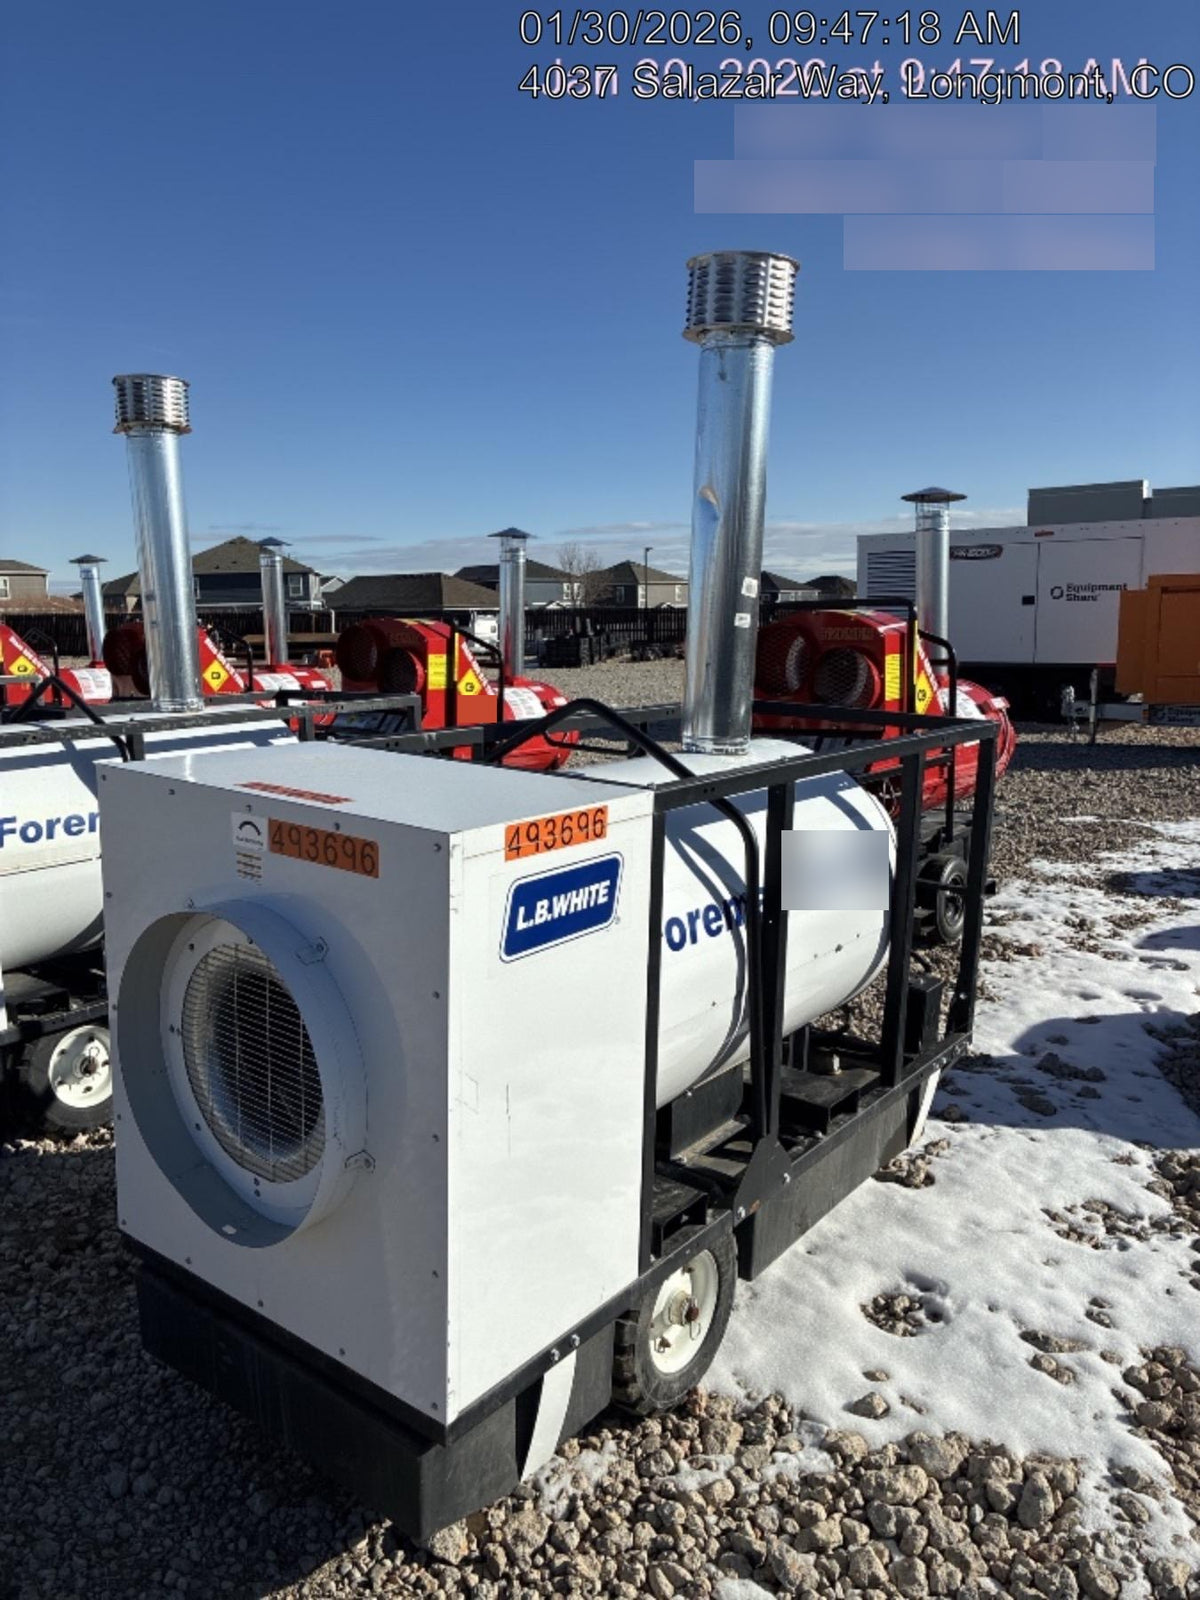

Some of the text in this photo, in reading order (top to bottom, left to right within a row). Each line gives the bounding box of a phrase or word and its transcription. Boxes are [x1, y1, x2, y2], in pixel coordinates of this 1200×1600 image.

[271, 822, 376, 875] 493696
[507, 808, 605, 856] 493696
[516, 879, 611, 931] L.B.WHITE
